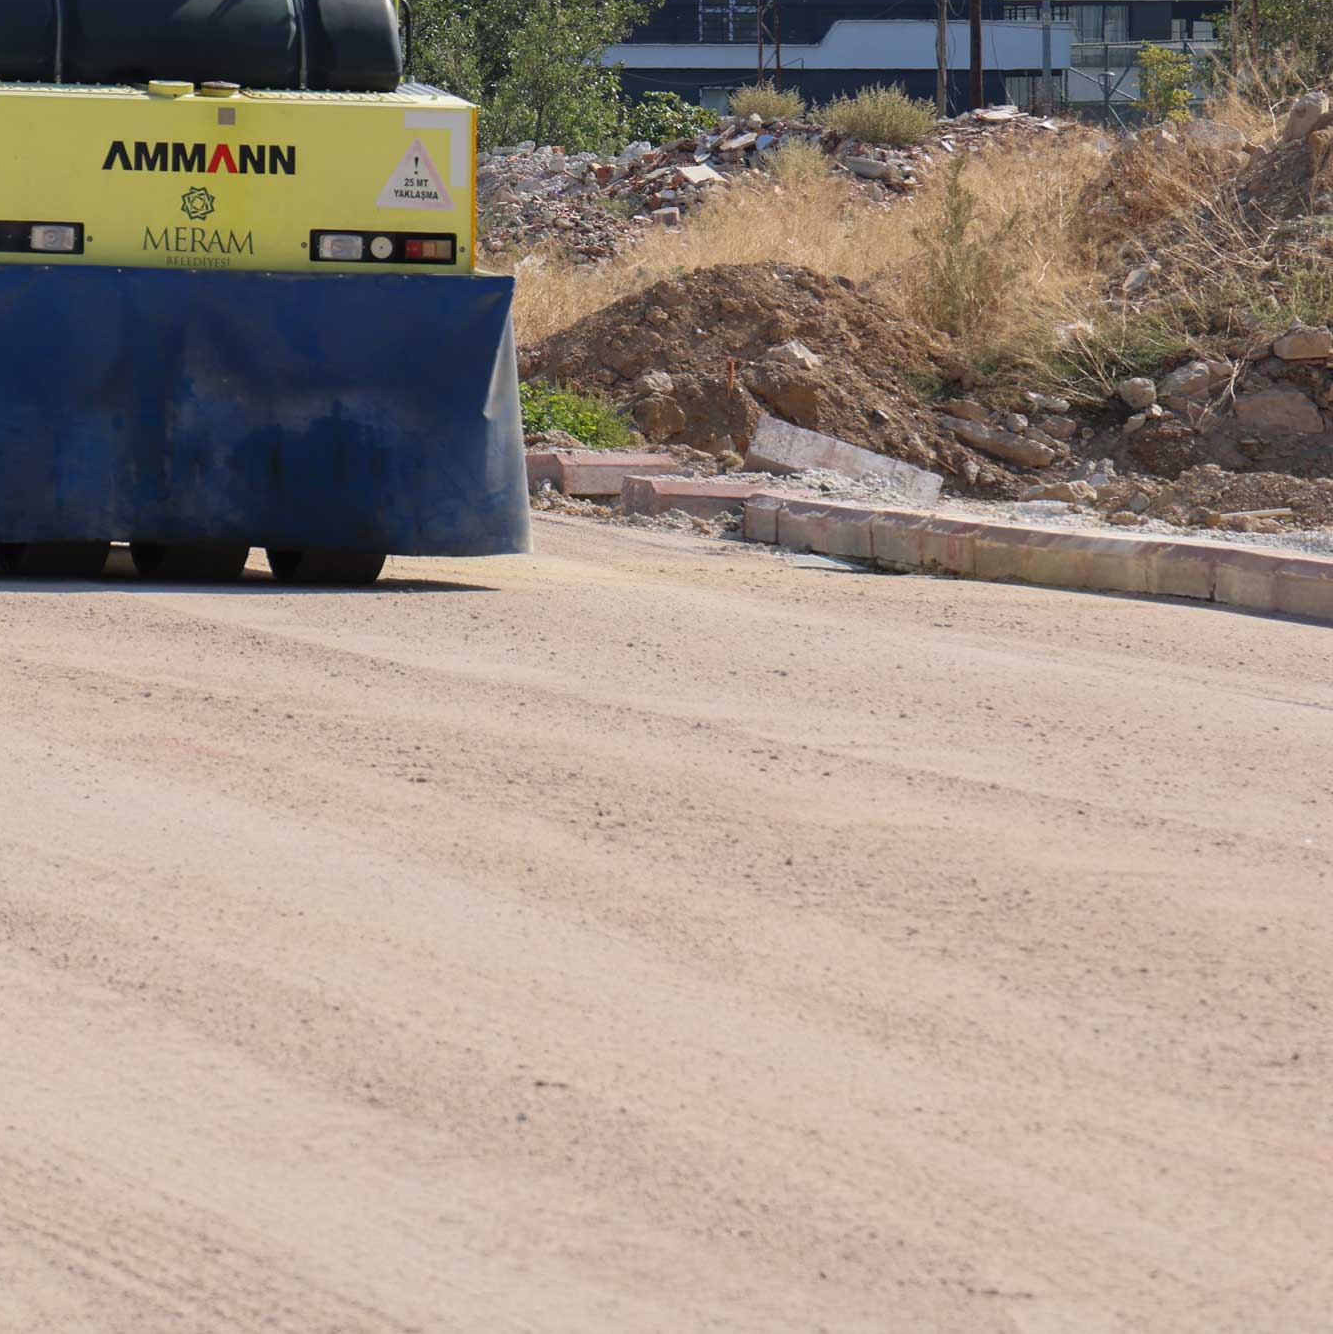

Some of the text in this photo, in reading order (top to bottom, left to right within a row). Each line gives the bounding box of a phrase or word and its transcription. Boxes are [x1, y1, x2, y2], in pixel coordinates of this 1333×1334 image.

[101, 141, 297, 175] AMMANN
[404, 178, 429, 187] 25 MT
[394, 188, 439, 201] YAKLAŞMA
[142, 226, 254, 255] MERAM
[165, 256, 231, 268] BELEDİYESİ
